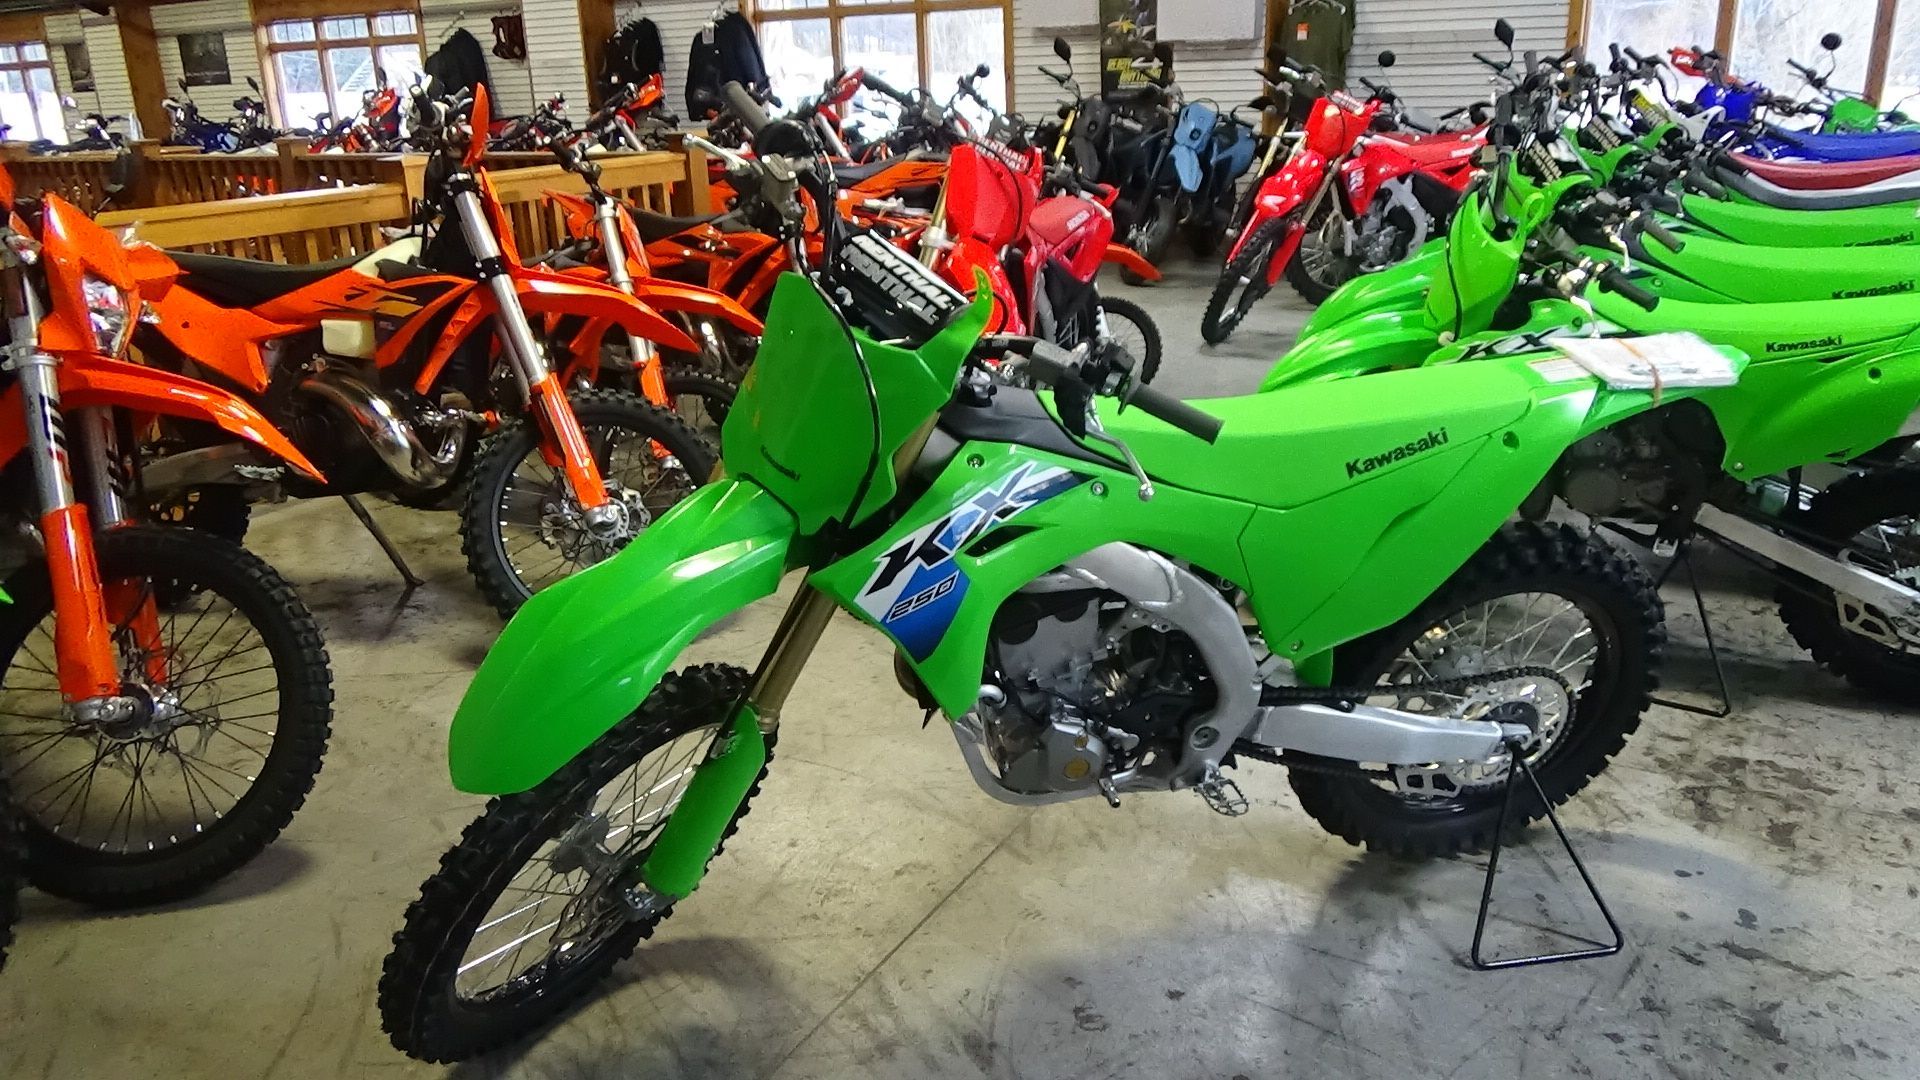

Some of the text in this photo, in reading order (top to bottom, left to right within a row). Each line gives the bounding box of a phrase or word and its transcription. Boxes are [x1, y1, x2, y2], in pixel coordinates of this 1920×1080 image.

[839, 243, 938, 326] RENTHAL
[851, 234, 953, 310] RENTHAL
[1765, 334, 1843, 352] Kawasaki
[1345, 426, 1449, 479] Kawasaki
[863, 460, 1039, 598] KX
[886, 570, 960, 623] 250
